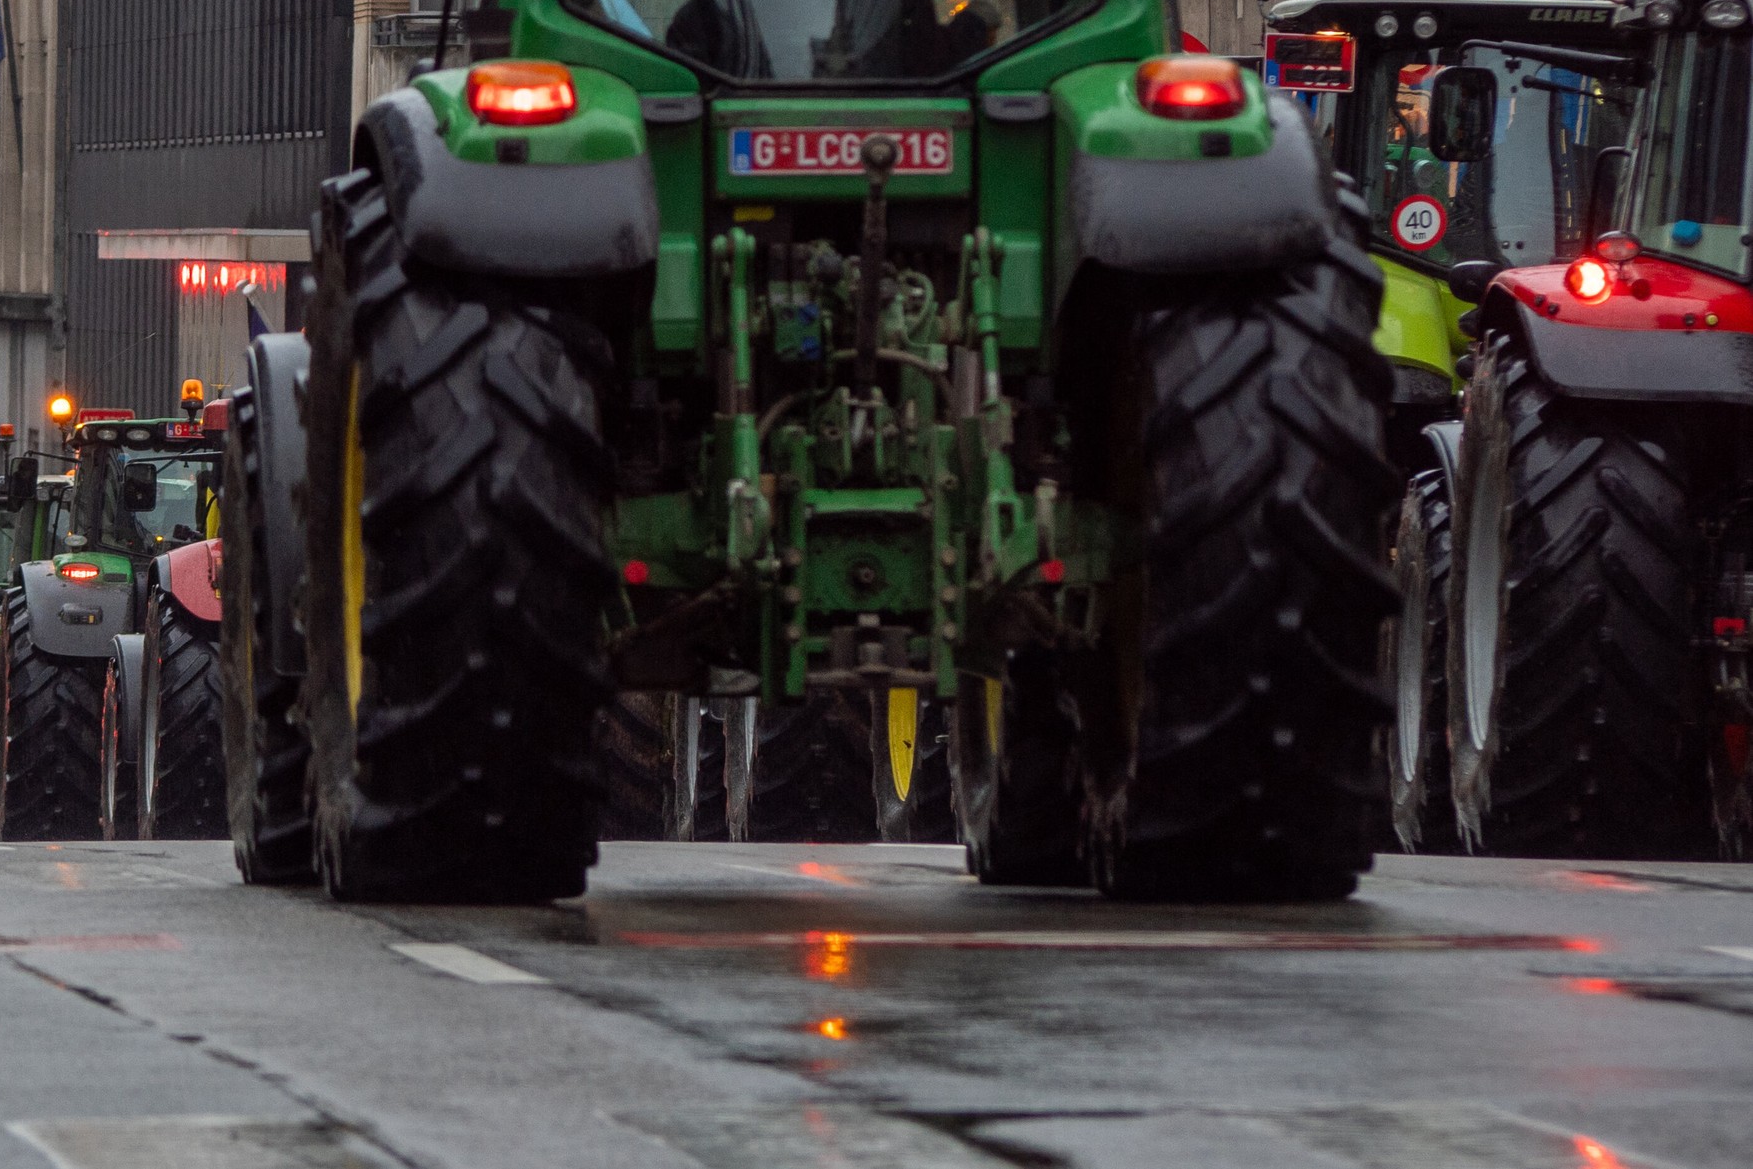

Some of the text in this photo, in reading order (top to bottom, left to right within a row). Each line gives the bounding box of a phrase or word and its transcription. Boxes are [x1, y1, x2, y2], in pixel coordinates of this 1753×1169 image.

[1529, 8, 1608, 23] CLAAS
[1405, 209, 1433, 229] 40
[1412, 231, 1426, 240] km
